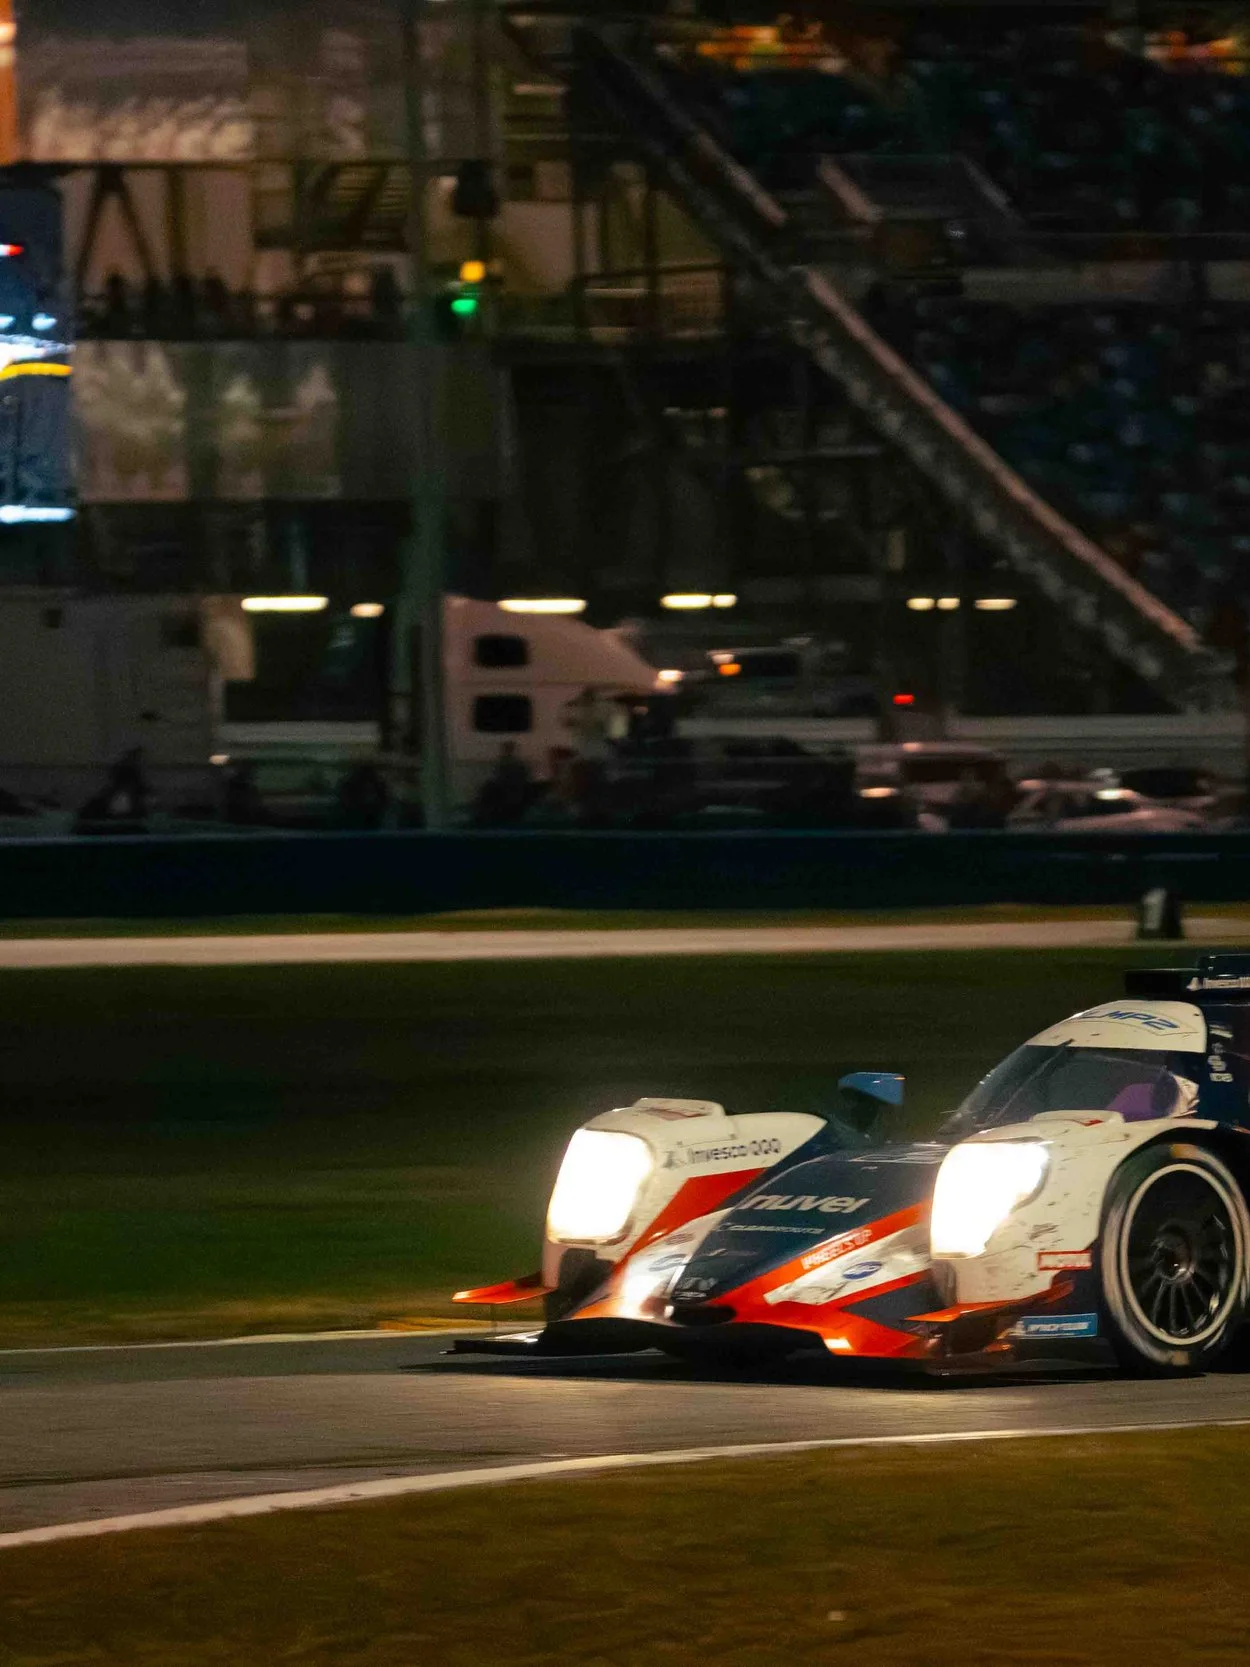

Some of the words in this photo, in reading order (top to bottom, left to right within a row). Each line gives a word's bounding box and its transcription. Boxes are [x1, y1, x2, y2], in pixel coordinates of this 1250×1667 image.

[1080, 1009, 1180, 1031] LMP2
[687, 1145, 748, 1164] Invesco
[748, 1138, 781, 1156] QQQ
[736, 1194, 872, 1213] nuvei
